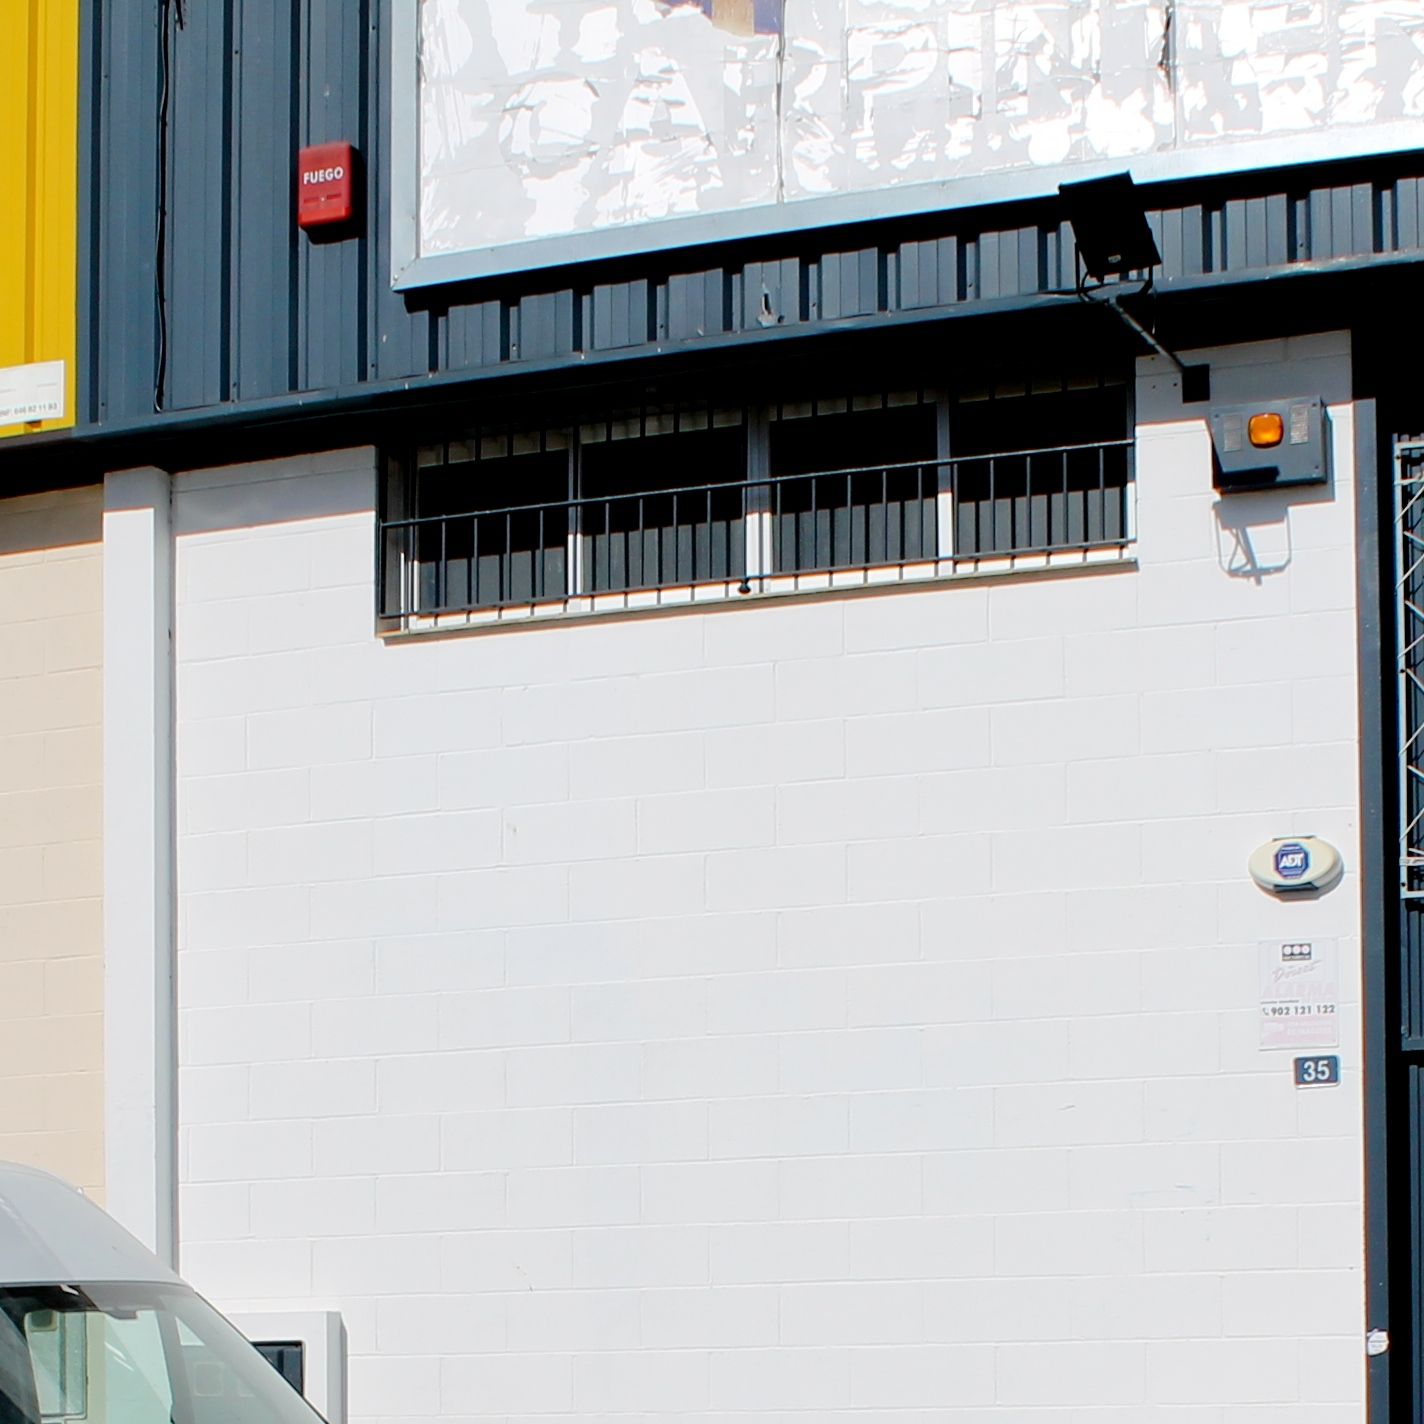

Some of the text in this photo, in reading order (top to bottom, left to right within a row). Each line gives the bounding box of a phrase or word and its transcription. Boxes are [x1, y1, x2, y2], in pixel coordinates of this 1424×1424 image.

[303, 166, 344, 185] FUEGO
[1278, 853, 1305, 869] ADT
[1270, 1004, 1335, 1016] 902 121 122
[1303, 1060, 1330, 1081] 35
